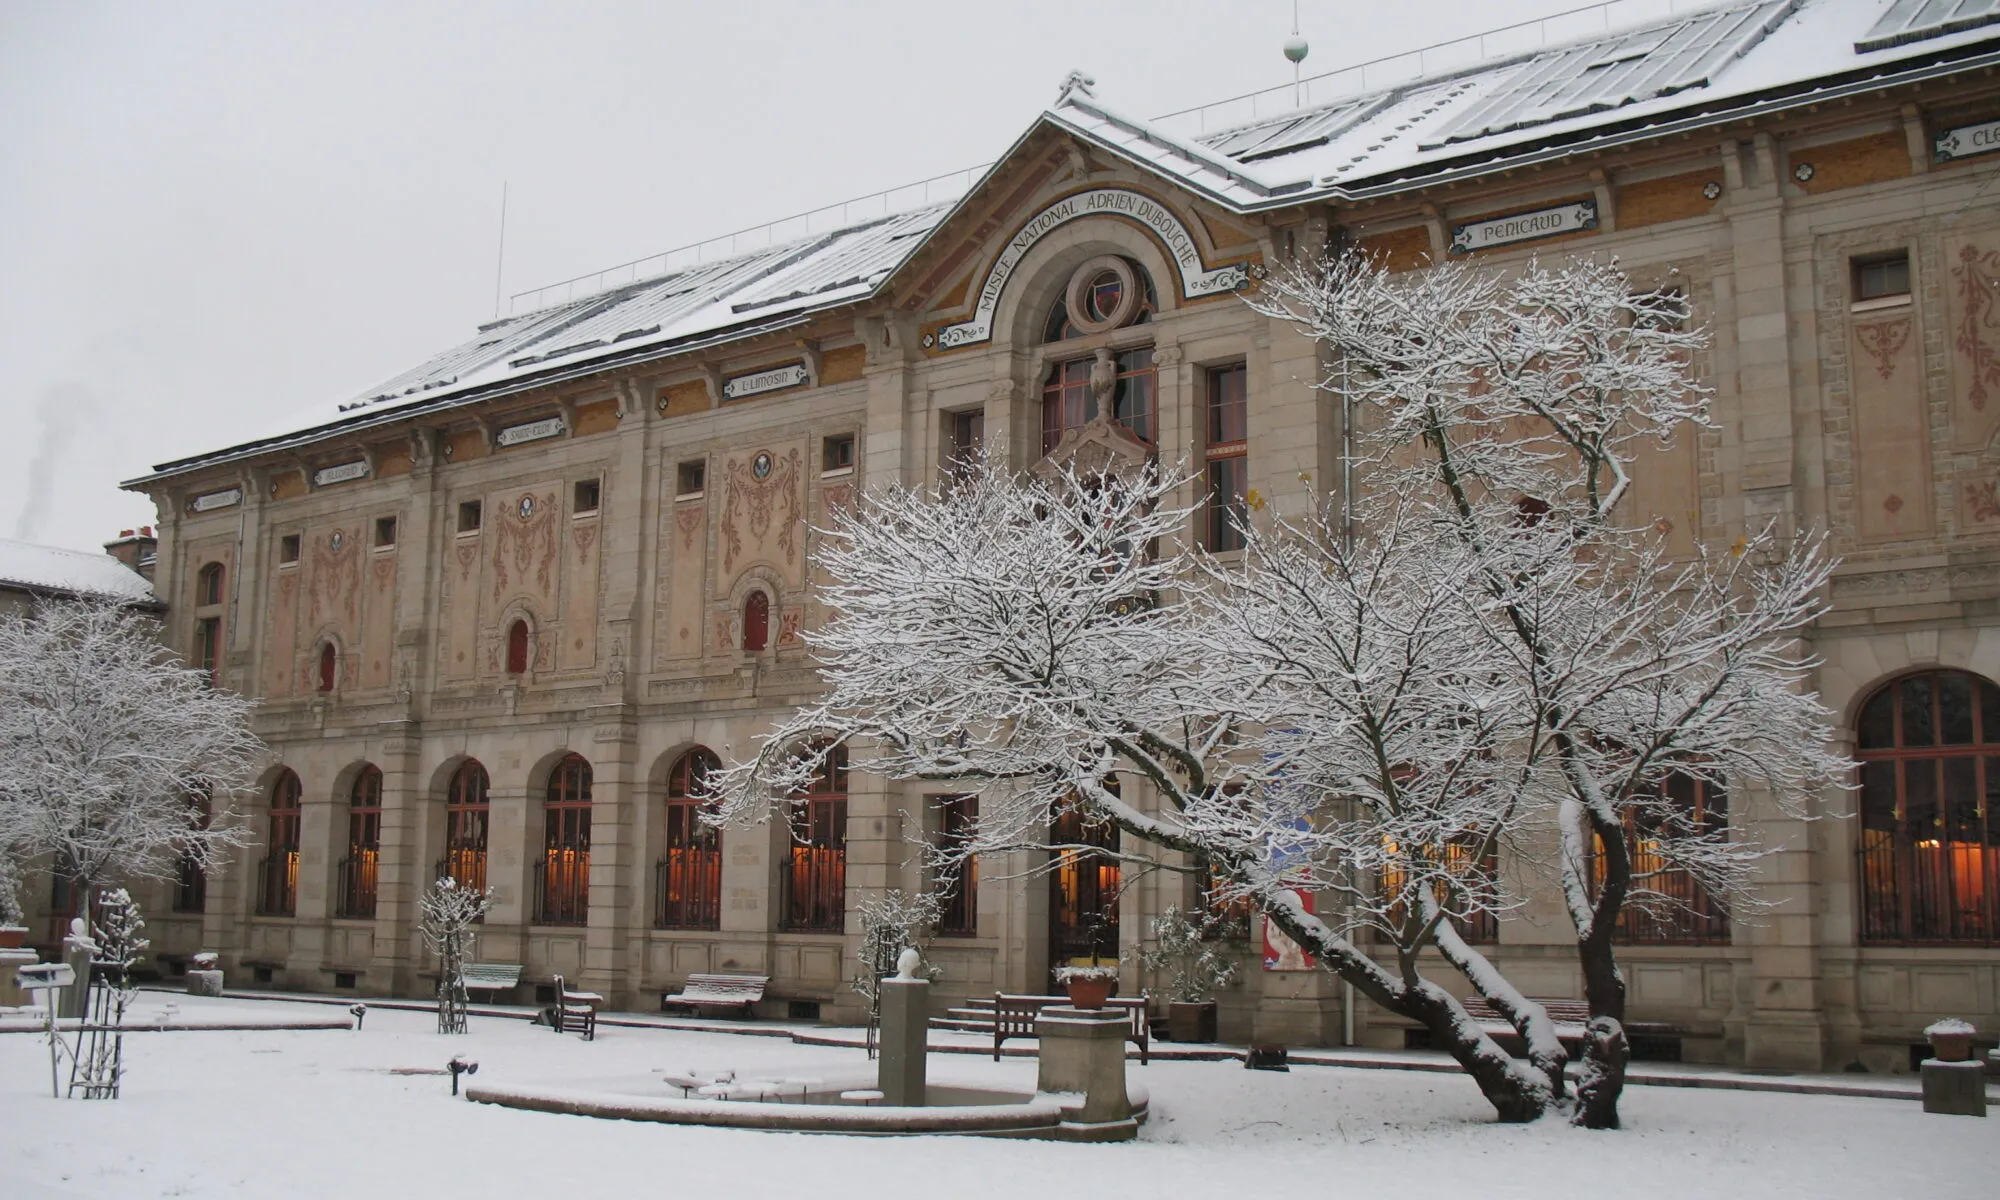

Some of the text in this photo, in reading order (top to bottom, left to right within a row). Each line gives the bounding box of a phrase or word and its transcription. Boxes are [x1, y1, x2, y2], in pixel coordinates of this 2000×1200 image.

[1013, 201, 1078, 253] NATIONAL
[1086, 193, 1137, 212] ADRIEN
[1138, 200, 1198, 269] DUBOUCHÉ
[1484, 213, 1562, 240] PENICAUD
